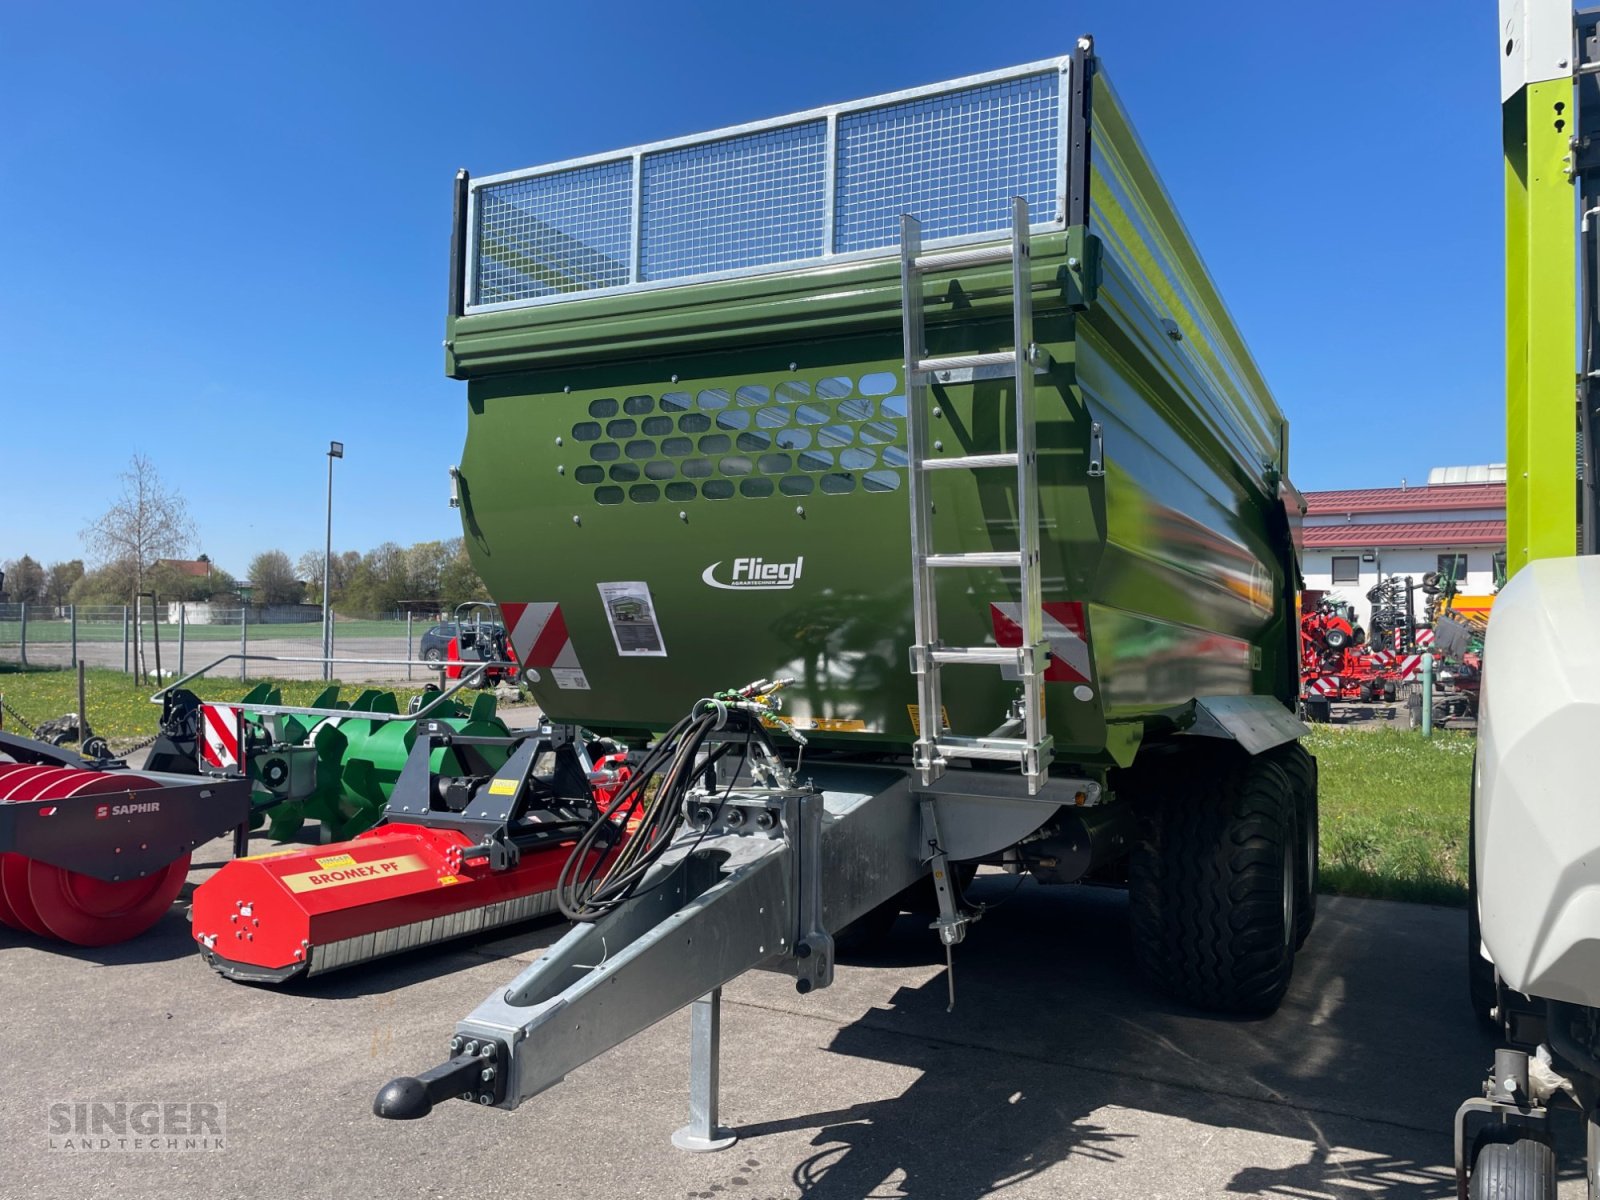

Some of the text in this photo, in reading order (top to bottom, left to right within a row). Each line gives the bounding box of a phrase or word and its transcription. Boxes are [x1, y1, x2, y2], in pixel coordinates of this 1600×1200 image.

[732, 556, 803, 585] Fliegl
[112, 802, 160, 816] SAPHIR
[309, 865, 379, 885] BROMEX
[381, 862, 399, 873] PF
